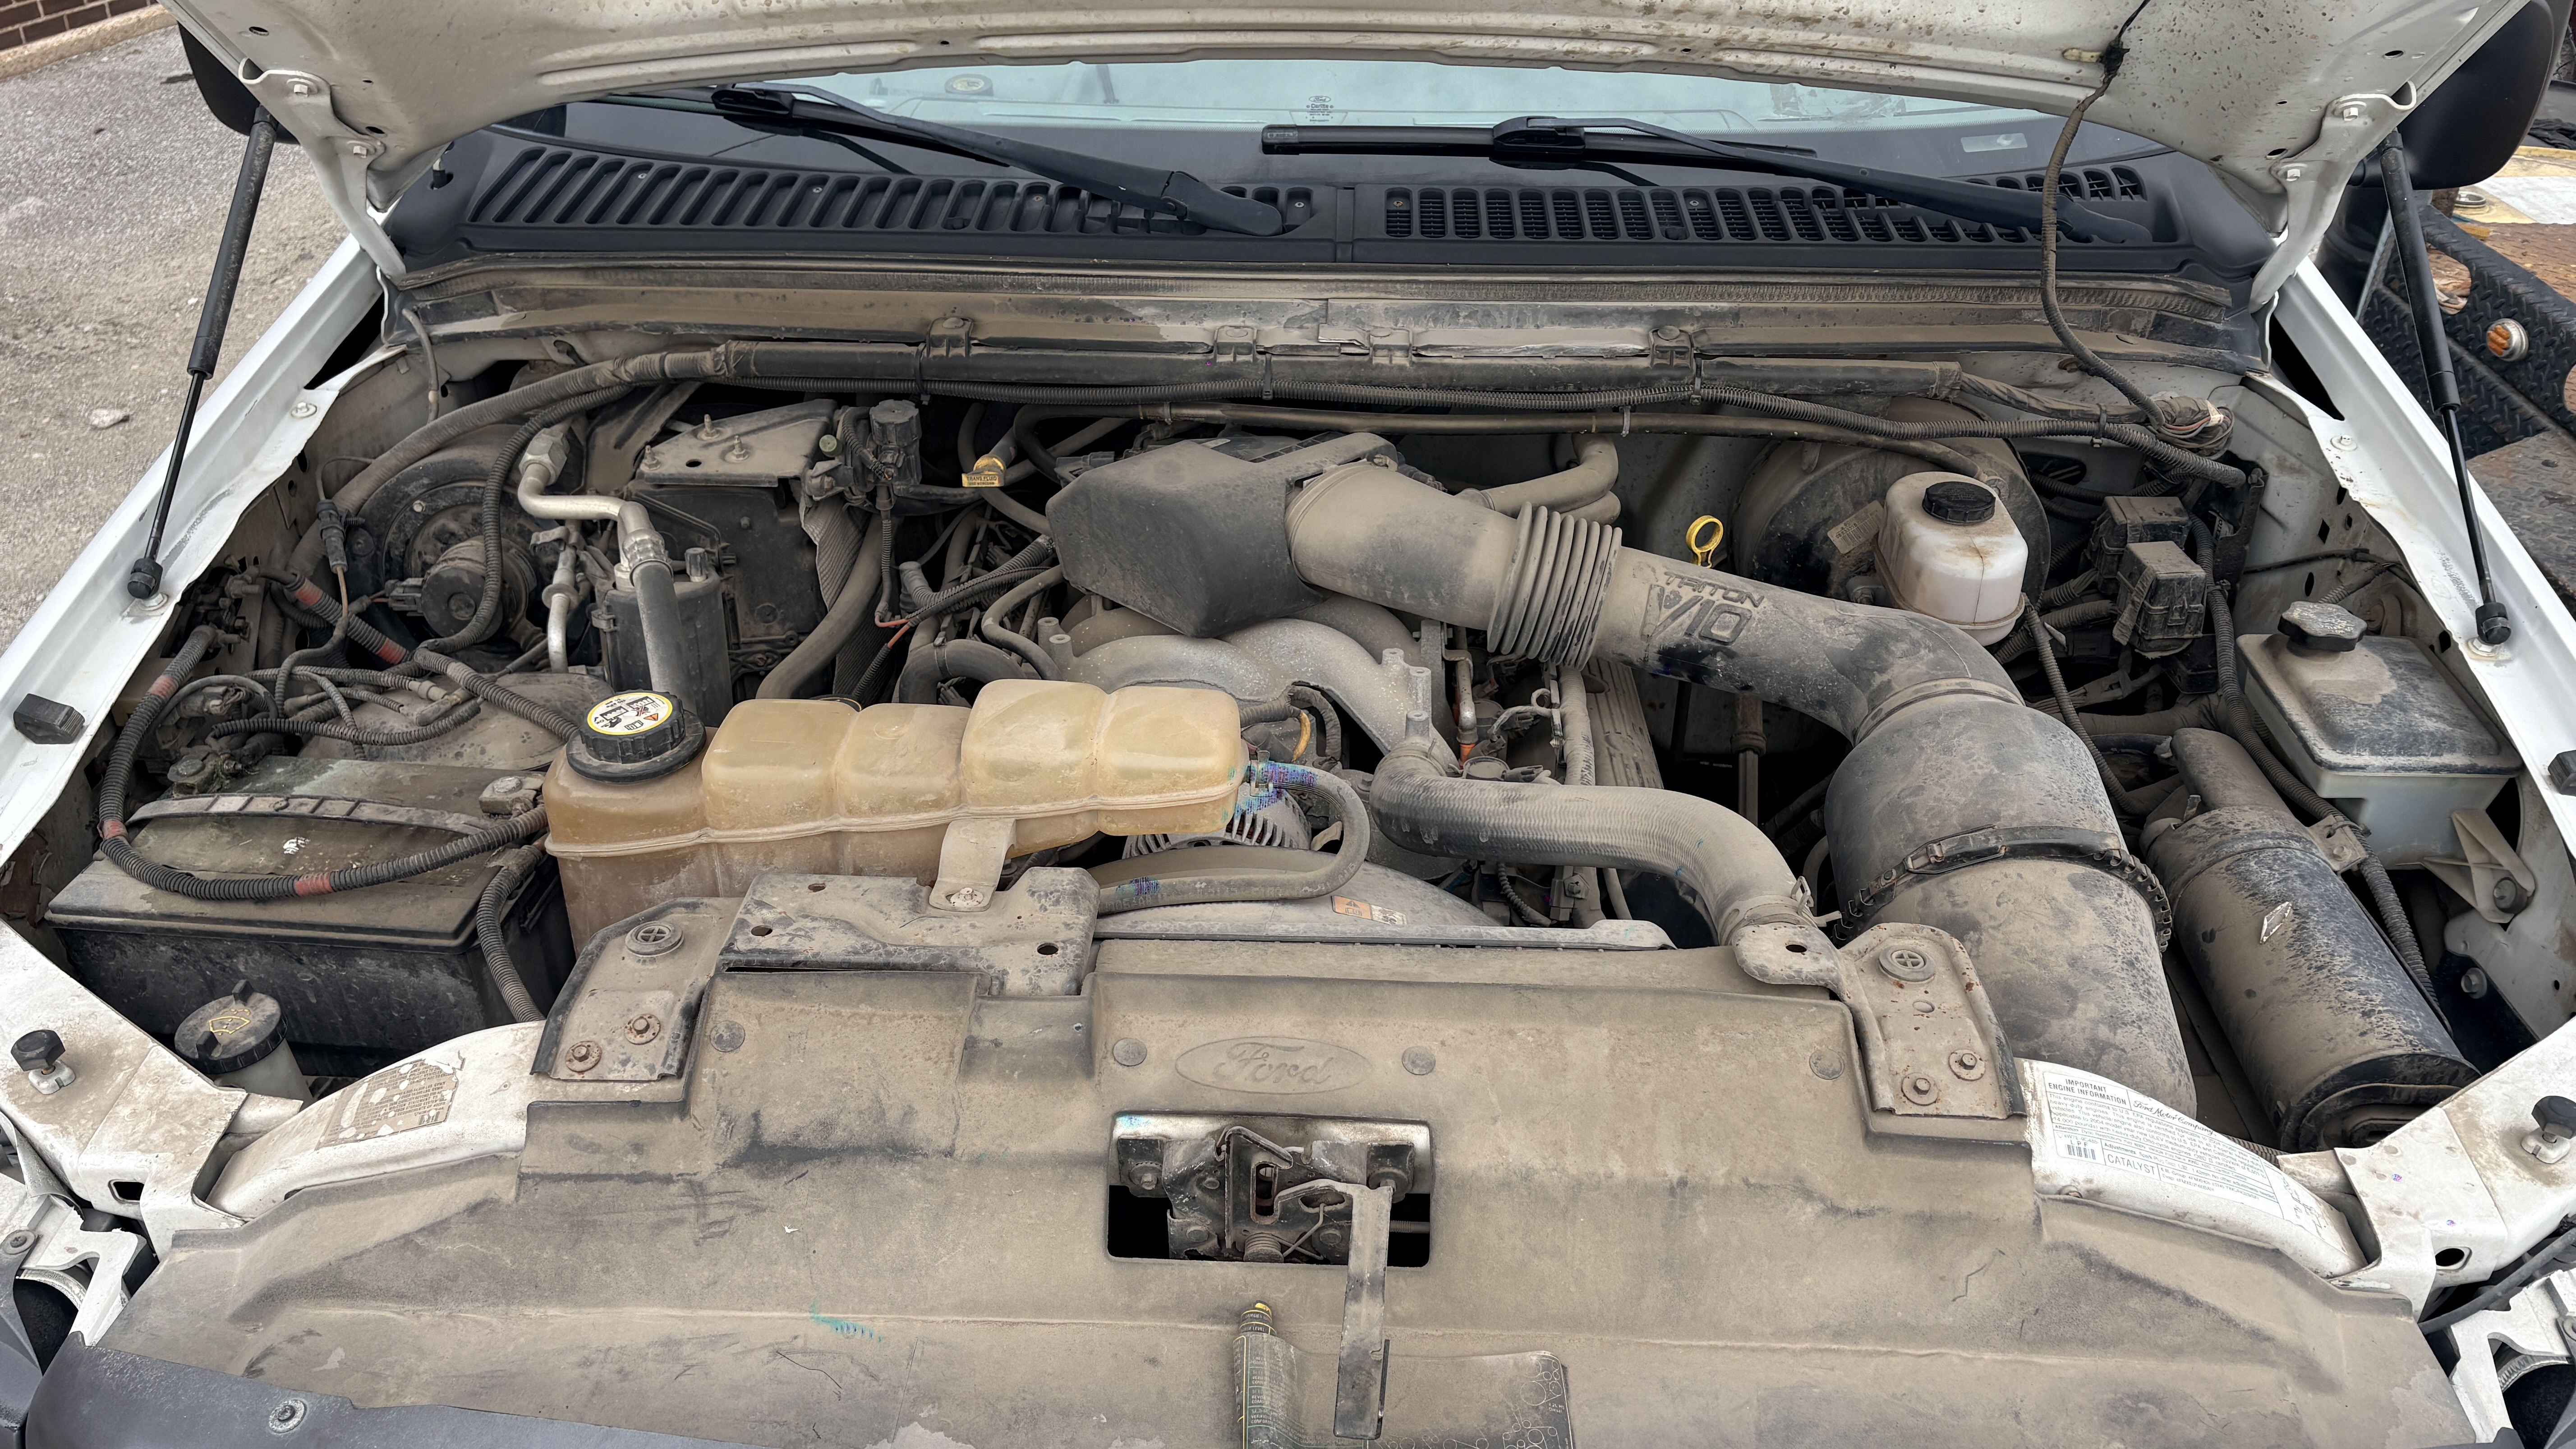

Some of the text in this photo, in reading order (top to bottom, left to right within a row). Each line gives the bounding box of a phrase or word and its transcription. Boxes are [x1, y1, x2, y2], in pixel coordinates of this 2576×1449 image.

[1664, 571, 1765, 608] TRITON
[1640, 584, 1753, 645] V10
[1213, 1042, 1332, 1084] Ford
[2048, 1082, 2126, 1105] ENGINE INFORMATION
[2065, 1079, 2106, 1093] IMPORTANT
[2134, 1100, 2153, 1112] Ford
[2152, 1108, 2178, 1120] Motor
[2107, 1154, 2155, 1175] CATALYST
